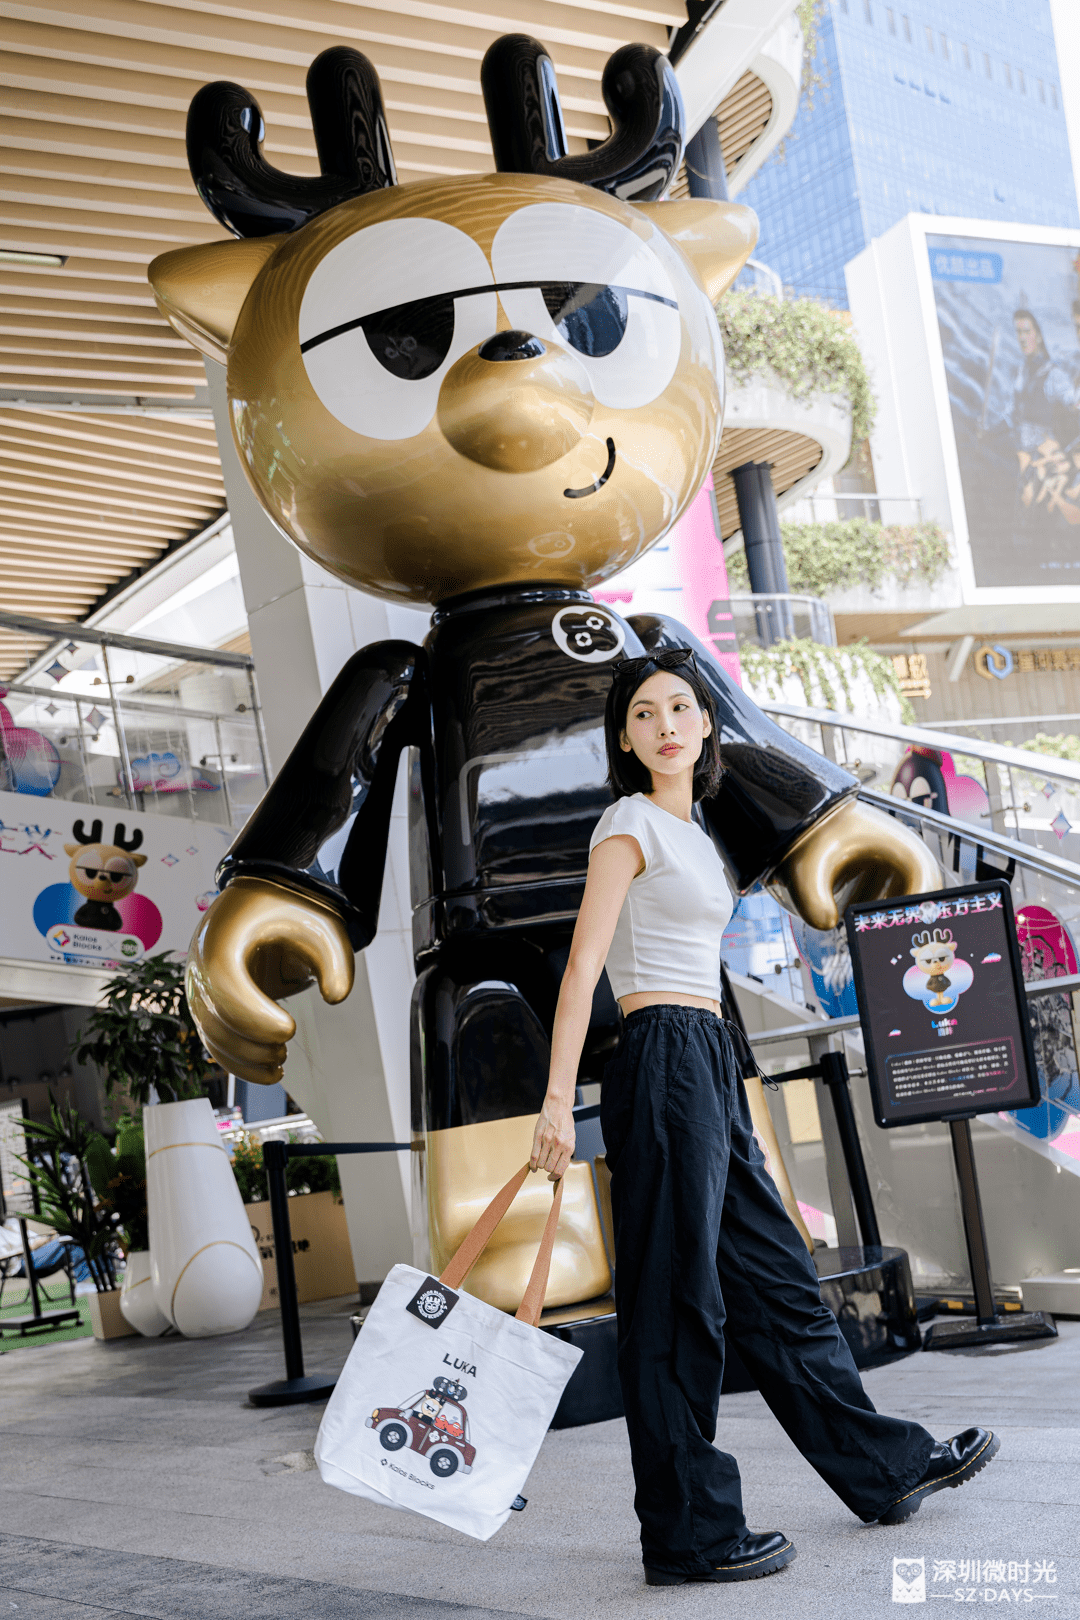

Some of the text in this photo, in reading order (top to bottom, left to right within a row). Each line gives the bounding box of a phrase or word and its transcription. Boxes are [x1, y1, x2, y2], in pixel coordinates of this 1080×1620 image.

[442, 1352, 477, 1378] LUKA
[388, 1463, 436, 1490] Kalos Blocks
